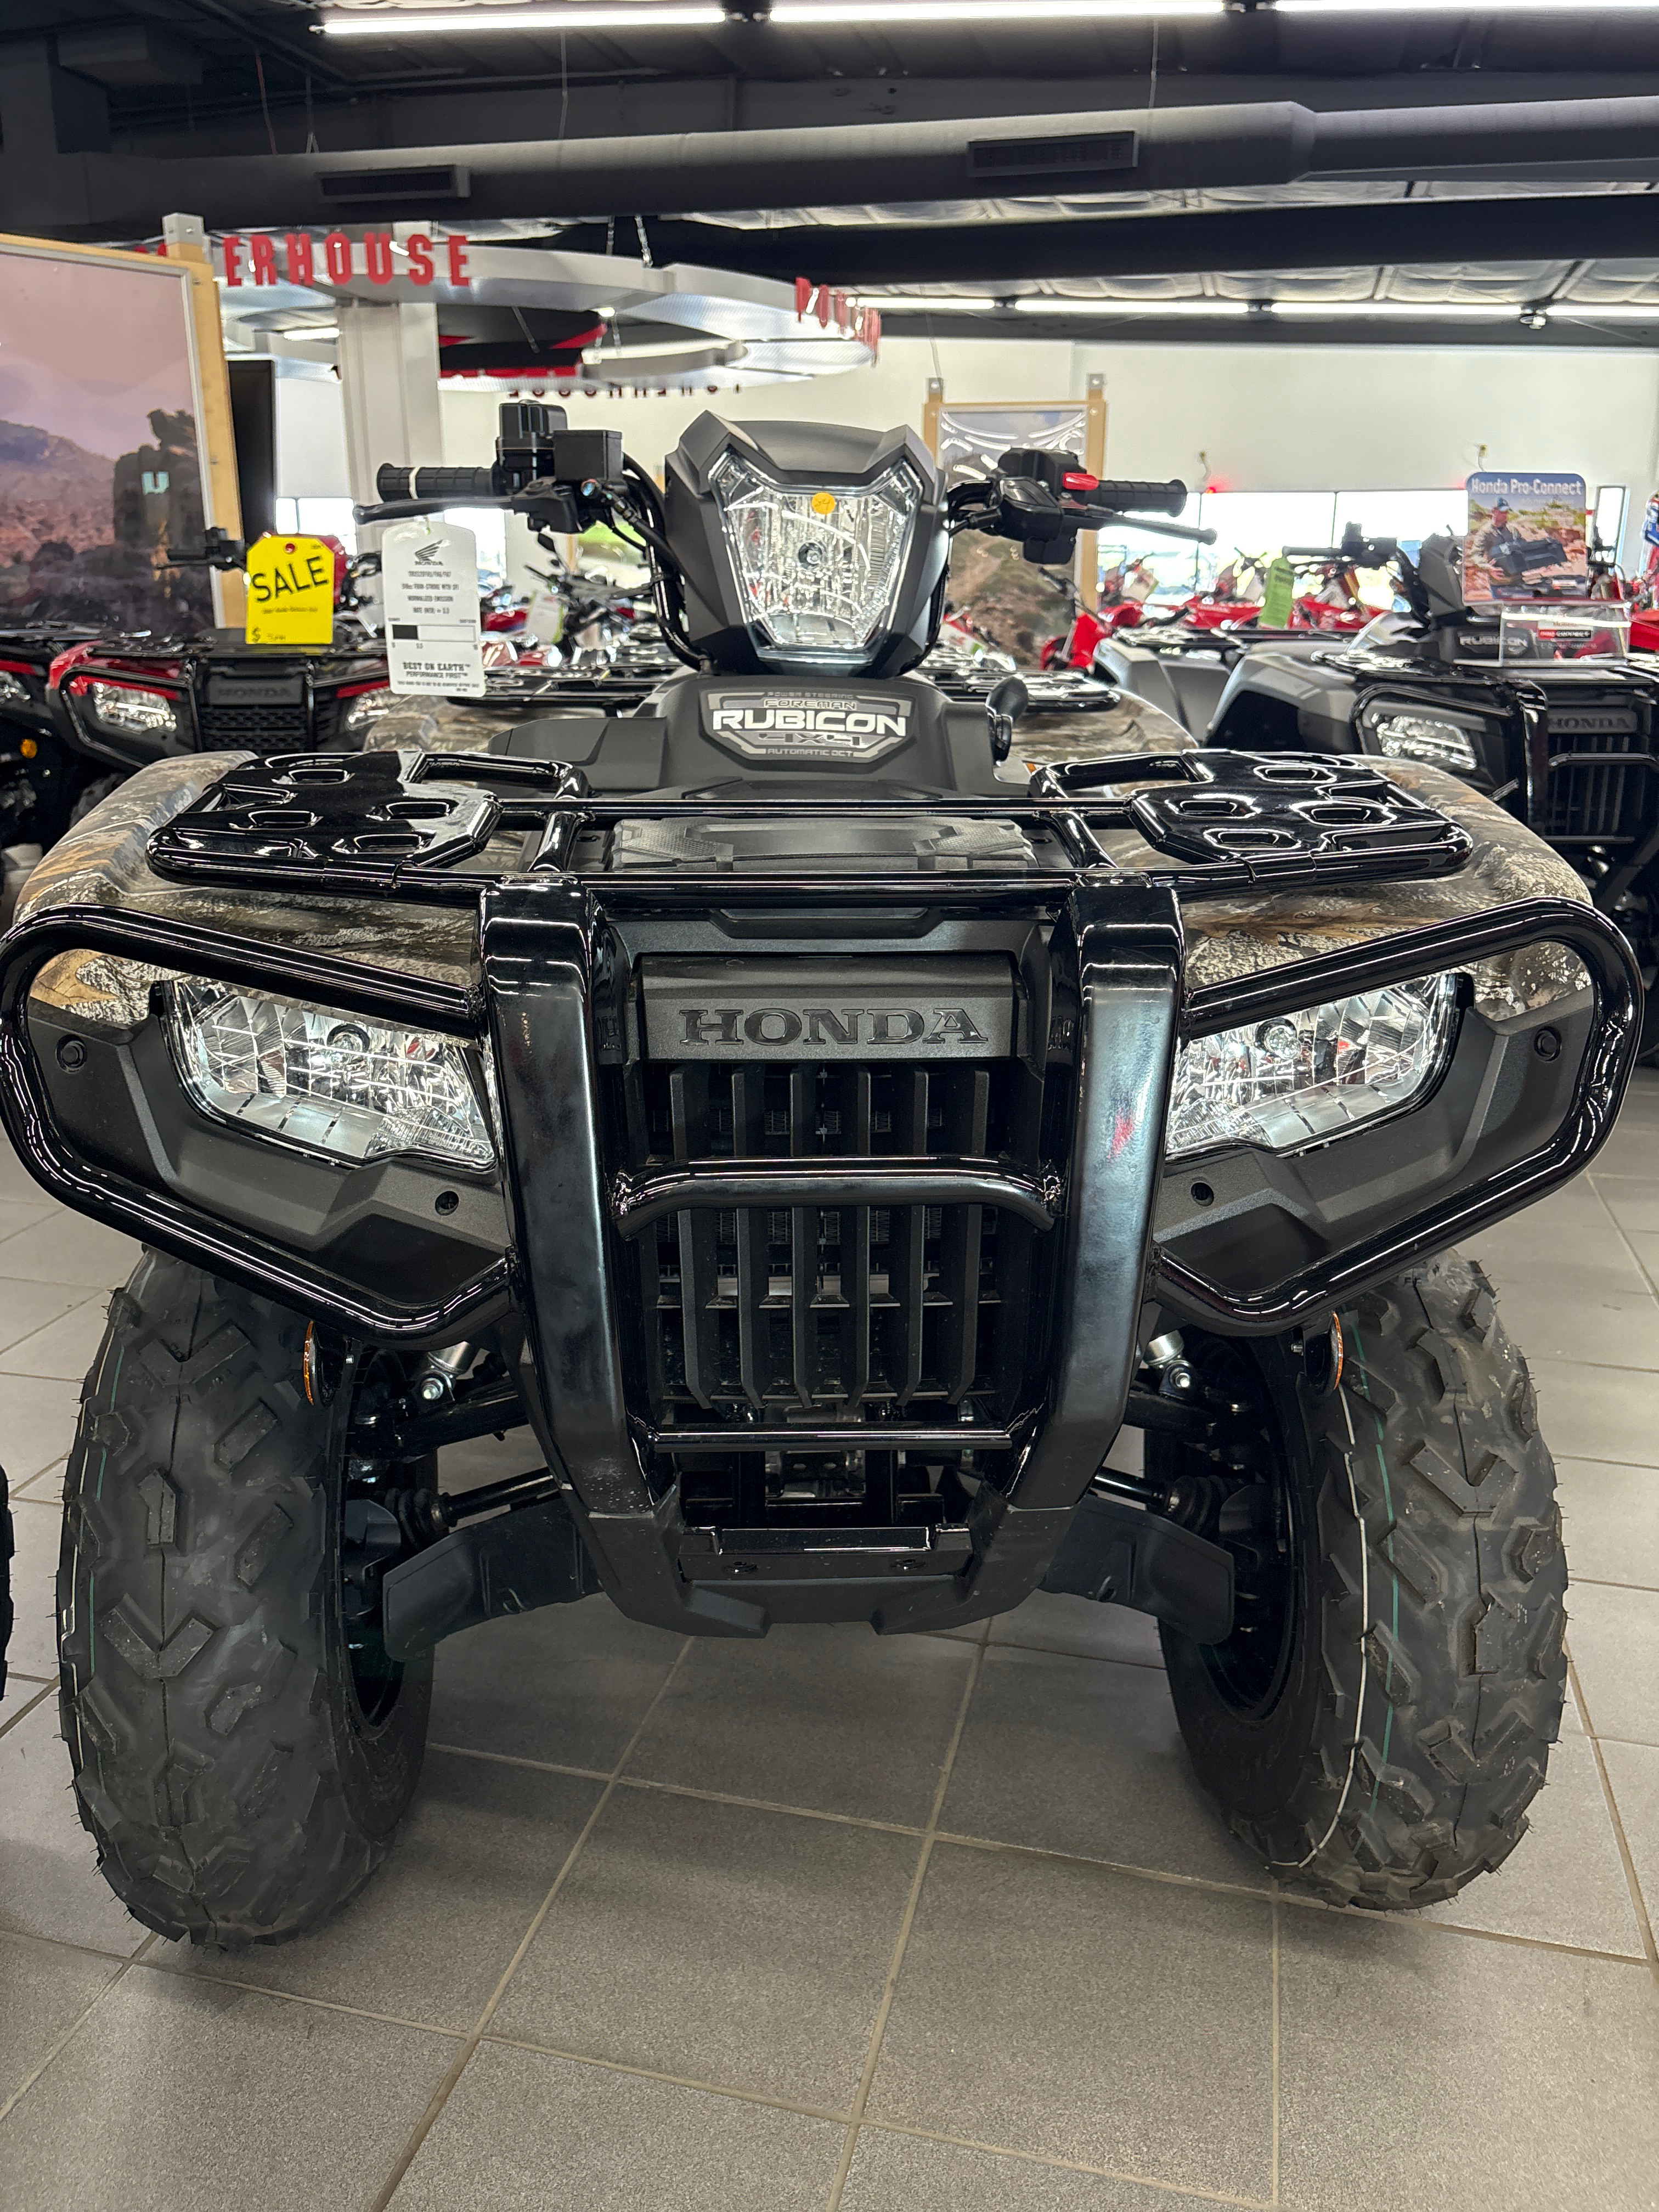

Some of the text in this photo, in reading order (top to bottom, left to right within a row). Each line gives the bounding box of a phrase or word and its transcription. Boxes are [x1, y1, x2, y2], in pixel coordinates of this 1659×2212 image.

[222, 232, 470, 286] ERHOUSE
[1471, 478, 1508, 494] Honda
[252, 556, 329, 601] SALE
[763, 698, 857, 710] FOREMAN
[713, 709, 906, 736] RUBICON
[679, 1008, 988, 1046] HONDA
